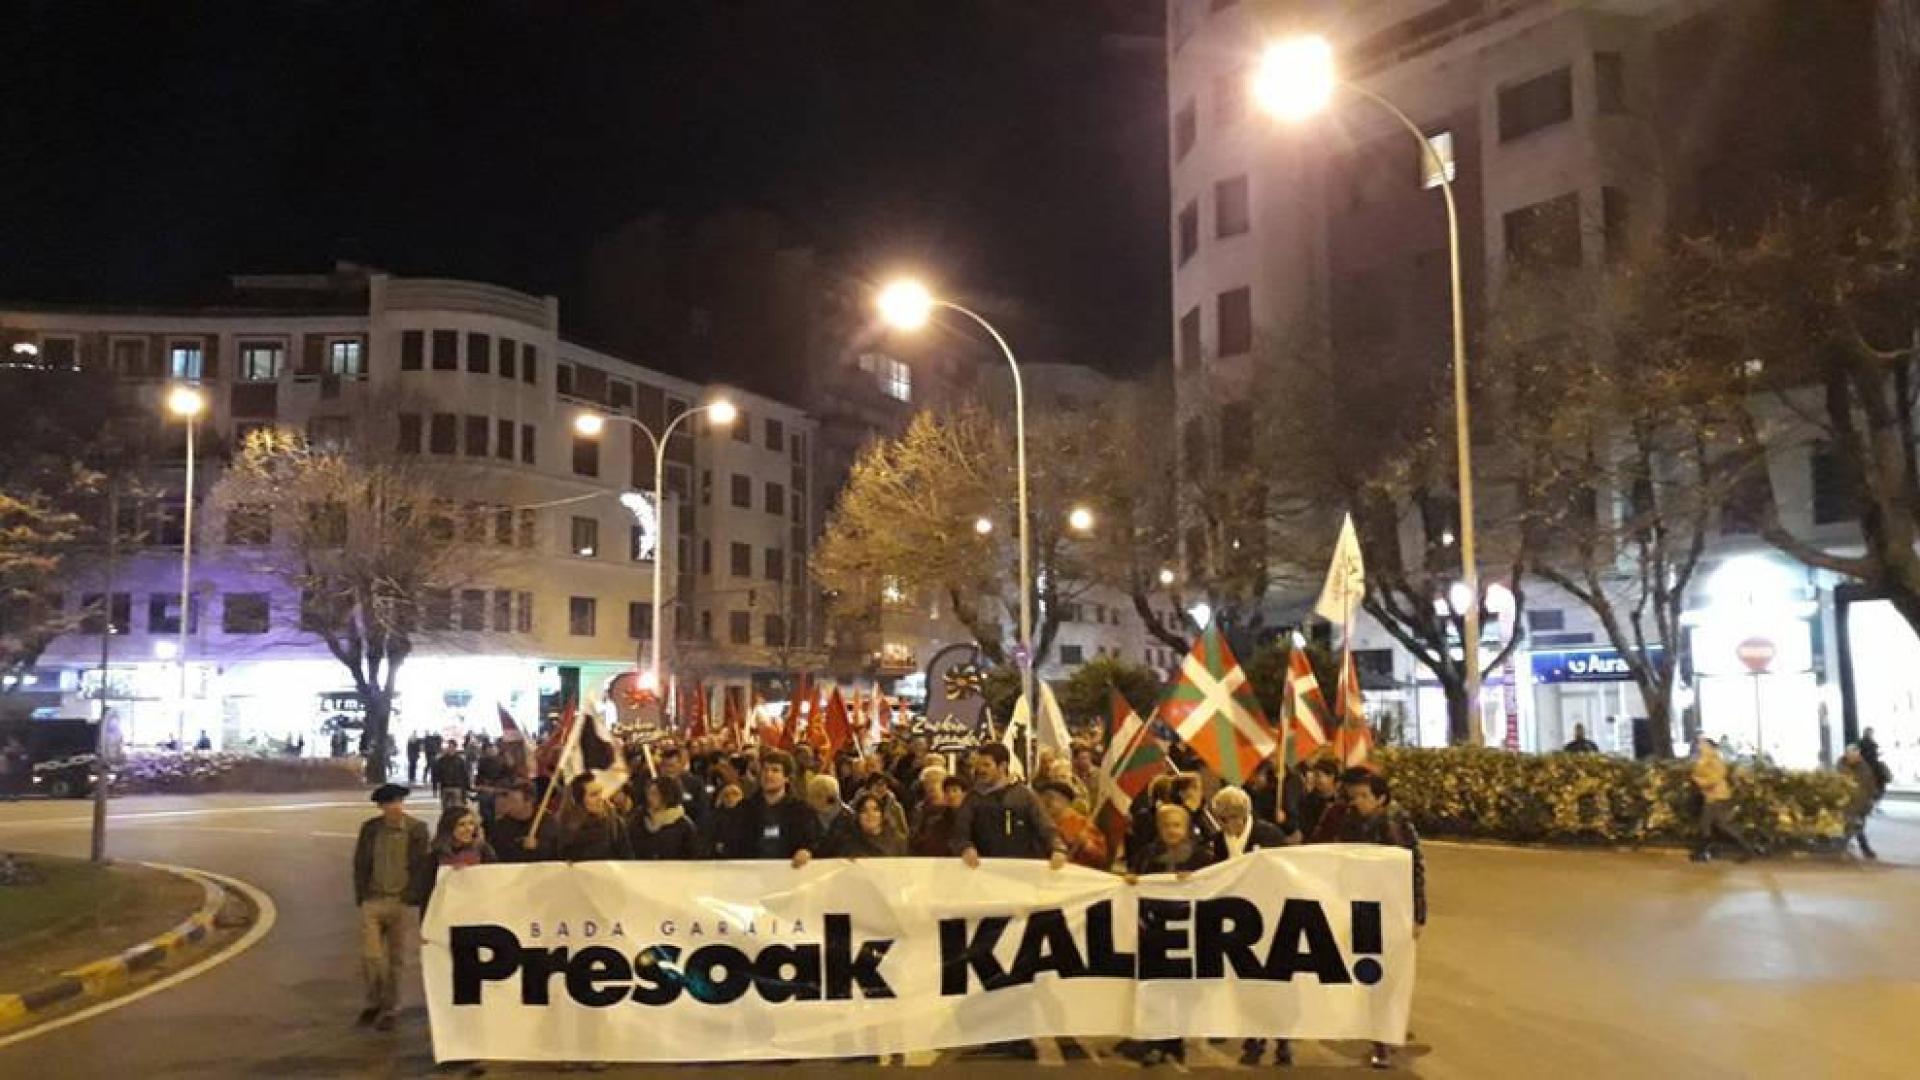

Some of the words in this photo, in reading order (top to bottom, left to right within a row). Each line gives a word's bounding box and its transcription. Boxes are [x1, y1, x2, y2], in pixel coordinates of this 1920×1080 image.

[449, 913, 897, 1007] Presoak
[938, 897, 1383, 997] KALERA!
[530, 921, 625, 938] BADA
[660, 919, 806, 937] GARAIA
